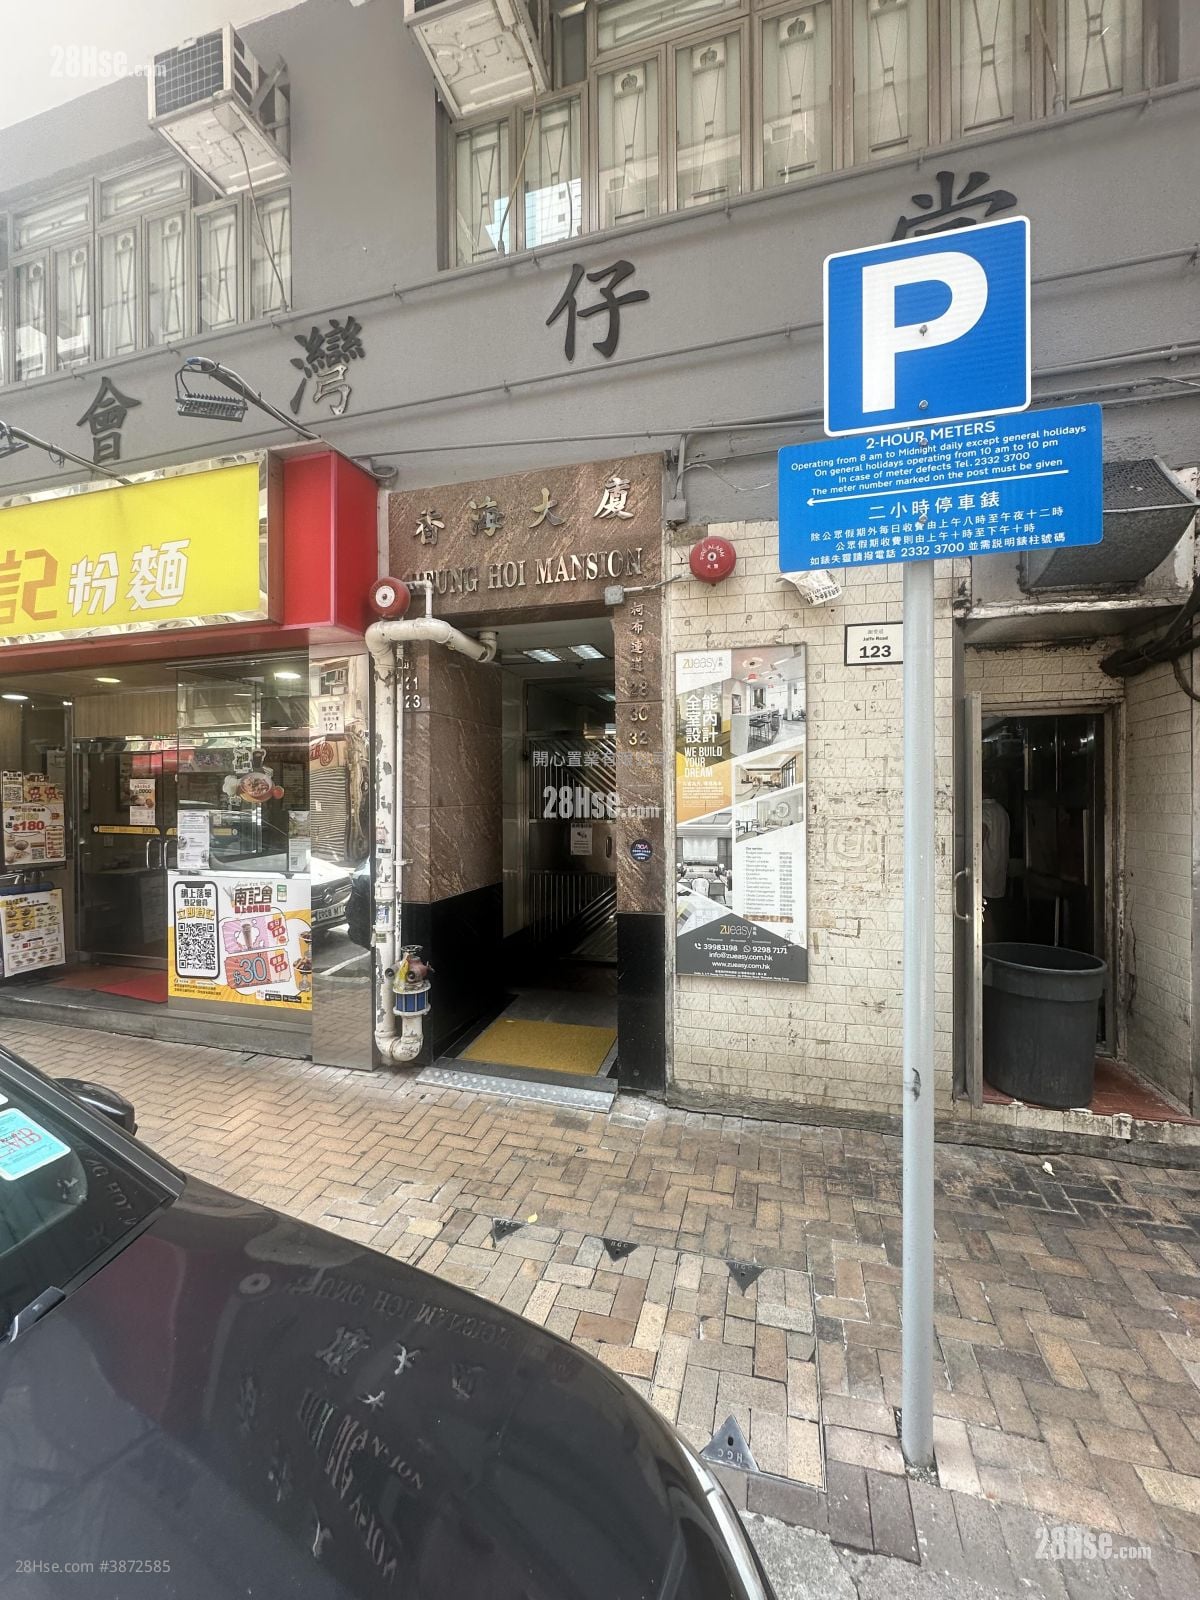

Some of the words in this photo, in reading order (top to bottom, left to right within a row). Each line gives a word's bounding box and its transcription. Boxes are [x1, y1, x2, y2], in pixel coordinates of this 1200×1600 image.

[862, 251, 988, 413] P
[866, 432, 925, 449] 2-HOUR
[930, 421, 996, 440] METERS
[791, 459, 834, 471] Operating
[836, 455, 857, 465] from
[860, 454, 866, 462] 8
[869, 453, 883, 461] am
[886, 451, 895, 459] to
[898, 445, 937, 457] Midnight
[940, 441, 963, 452] daily
[966, 437, 999, 448] except
[1002, 432, 1040, 444] general
[1043, 425, 1087, 437] holidays
[814, 469, 827, 477] On
[830, 464, 863, 476] general
[865, 459, 904, 471] holidays
[906, 453, 951, 465] operating
[954, 449, 977, 458] from
[980, 446, 992, 455] 10
[994, 446, 1010, 454] am
[1013, 443, 1024, 451] to
[1027, 440, 1039, 449] 10
[1042, 440, 1059, 449] pm
[839, 475, 847, 483] In
[850, 474, 871, 482] case
[873, 471, 883, 479] of
[885, 468, 912, 477] meter
[915, 463, 951, 473] defects
[1003, 452, 1030, 462] 3700
[812, 487, 828, 496] The
[830, 484, 856, 494] meter
[859, 479, 893, 490] number
[895, 475, 930, 486] marked
[933, 473, 945, 481] on
[948, 471, 963, 479] the
[966, 468, 989, 479] post
[992, 465, 1017, 474] must
[1019, 462, 1032, 470] be
[1035, 458, 1063, 470] given
[413, 477, 634, 545] 香海大廈
[869, 491, 1000, 520] 二小時停車錶
[901, 546, 930, 557] 2332
[934, 543, 965, 554] 3700
[408, 566, 479, 595] EUNG
[488, 559, 526, 589] HOI
[535, 547, 643, 585] MANSION
[860, 645, 892, 659] 123
[686, 694, 718, 710] 全能
[629, 706, 648, 721] 30
[686, 711, 718, 727] 室內
[325, 722, 337, 731] 121
[628, 732, 648, 746] 32
[686, 727, 718, 744] 設計
[685, 748, 698, 757] WE
[699, 746, 722, 757] BUILD
[685, 757, 706, 767] YOUR
[685, 767, 713, 778] DREAM
[13, 820, 45, 831] $180
[235, 885, 273, 906] 南記會
[720, 924, 753, 938] zueasy
[703, 943, 738, 952] 39983198
[709, 951, 773, 961] info@zueasy.com.hk
[233, 956, 268, 985] $30
[712, 961, 771, 970] www.zueasy.com.hk
[717, 1449, 743, 1463] HGC
